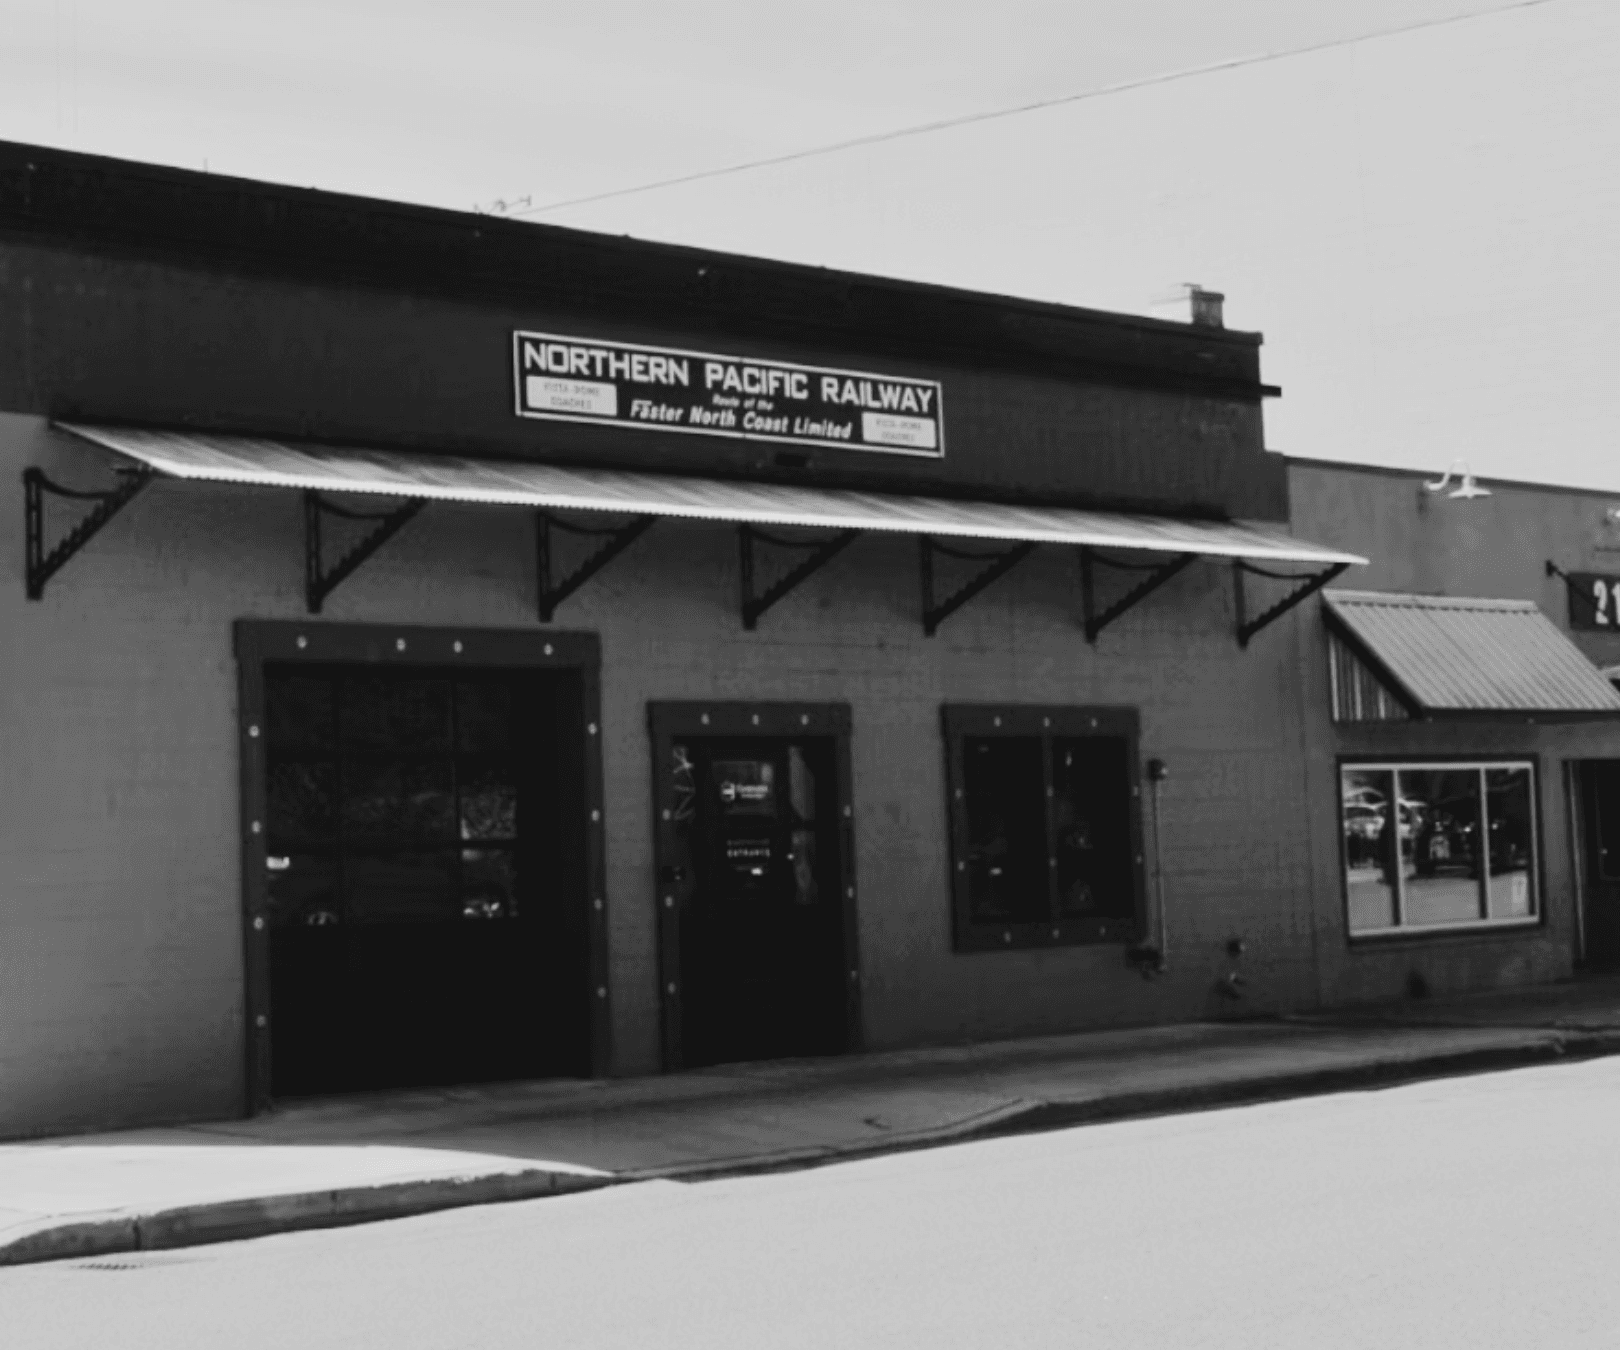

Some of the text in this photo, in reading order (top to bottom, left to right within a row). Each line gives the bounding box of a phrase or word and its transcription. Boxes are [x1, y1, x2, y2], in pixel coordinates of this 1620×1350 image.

[524, 341, 932, 413] NORTHERN PACIFIC RAILWAY
[630, 398, 684, 421] Faster
[688, 405, 736, 427] North
[743, 410, 789, 434] Coast
[793, 415, 853, 440] Limited
